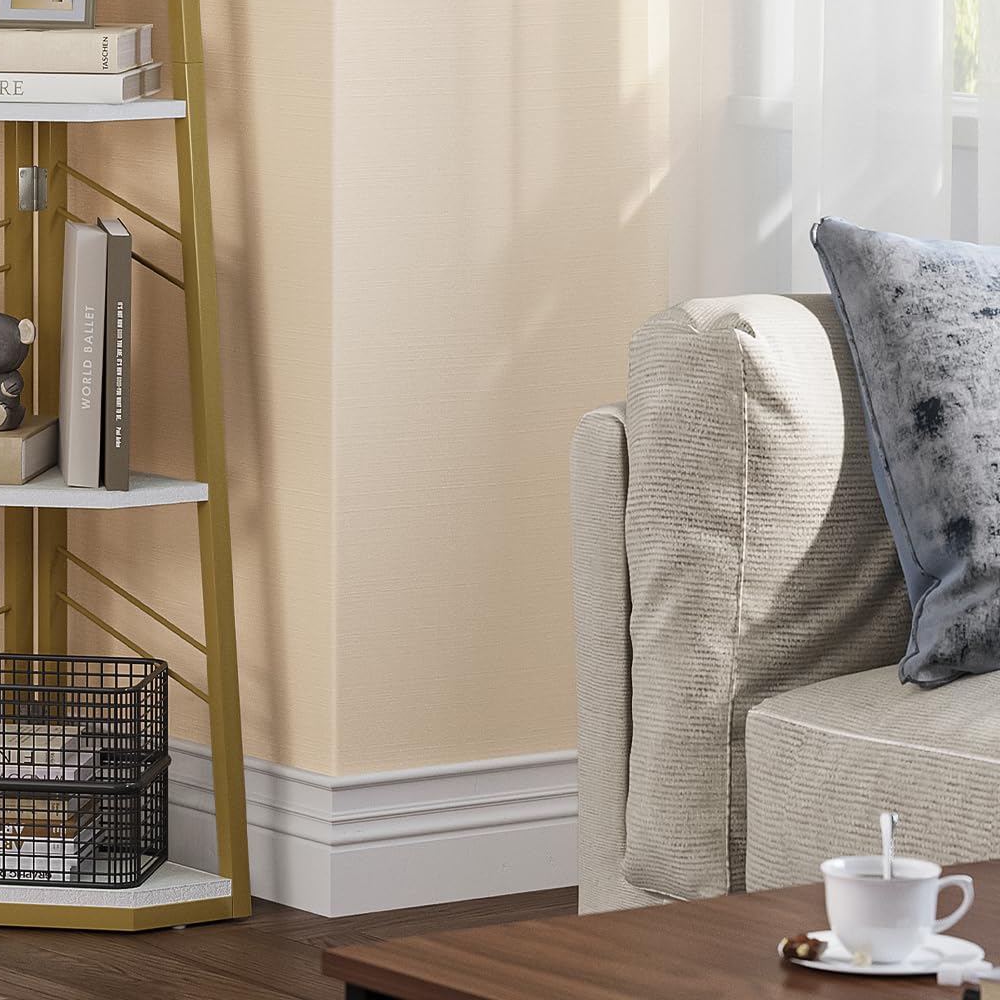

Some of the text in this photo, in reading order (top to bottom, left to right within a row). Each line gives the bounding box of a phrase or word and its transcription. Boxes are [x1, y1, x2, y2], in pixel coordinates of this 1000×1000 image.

[101, 36, 109, 70] TASCHEN
[81, 305, 95, 409] WORLD BALLET
